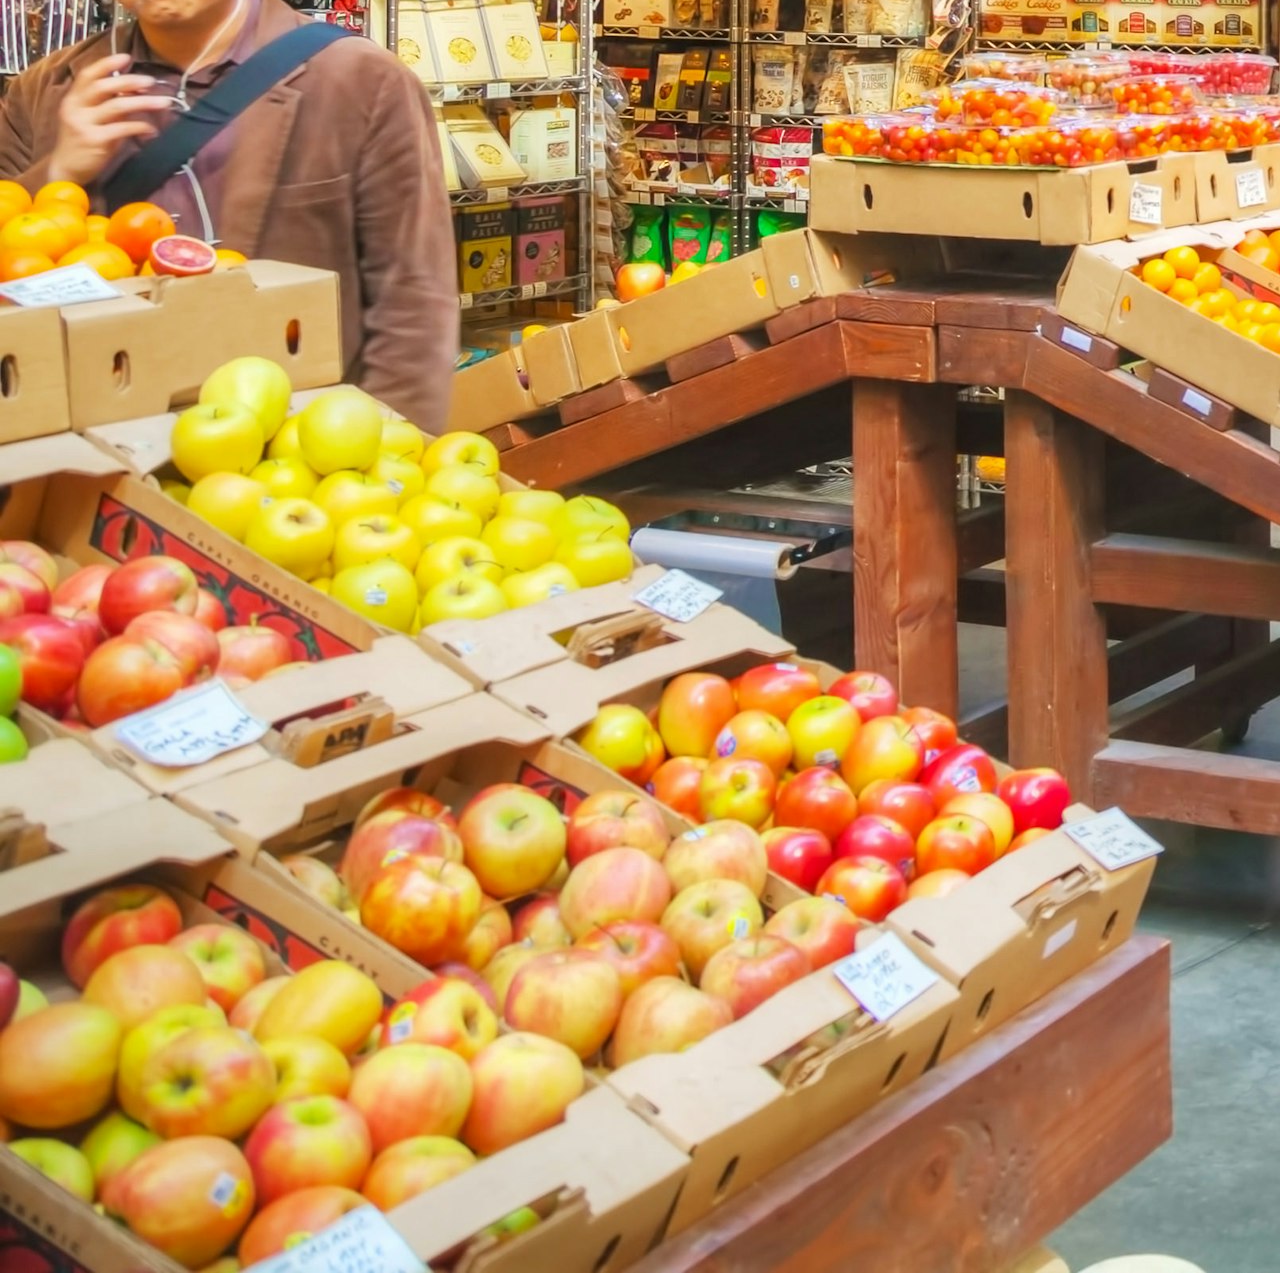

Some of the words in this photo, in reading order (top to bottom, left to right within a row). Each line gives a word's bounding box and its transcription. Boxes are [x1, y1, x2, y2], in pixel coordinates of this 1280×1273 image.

[472, 225, 506, 238] PASTA
[528, 219, 559, 231] PASTA
[187, 532, 233, 566] CAPAY
[251, 574, 320, 619] ORGANIC
[319, 936, 378, 978] CAPAY
